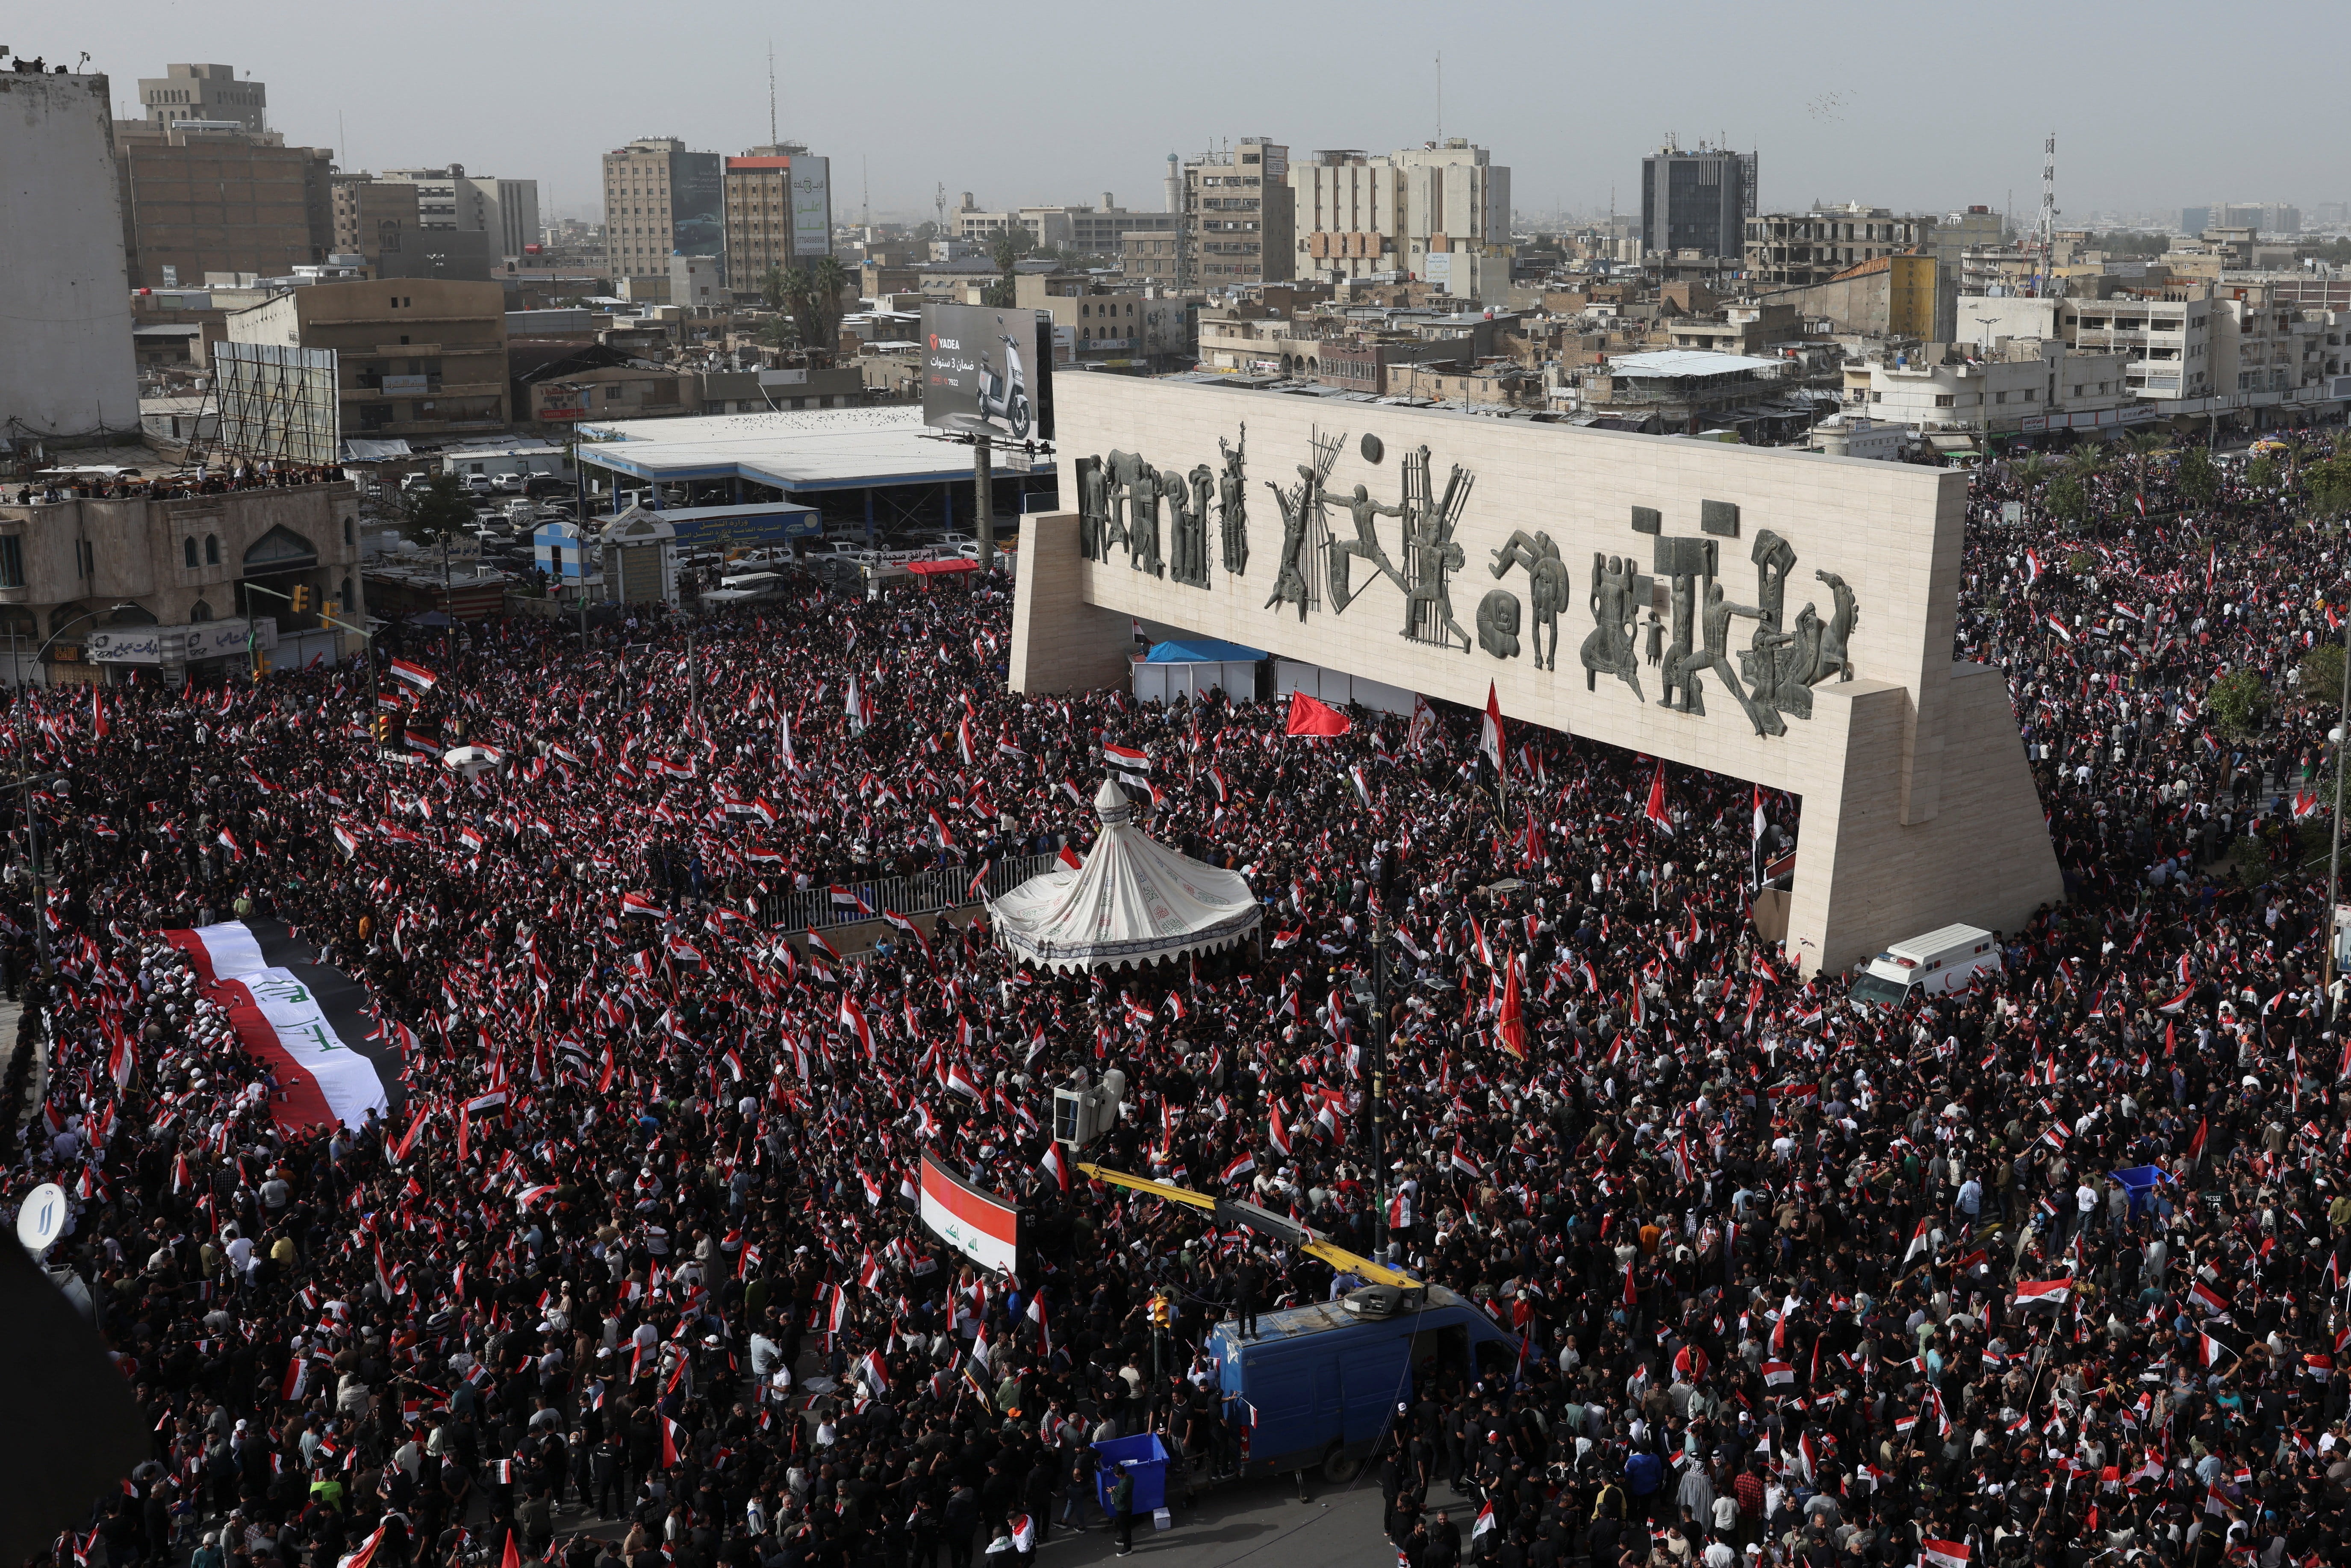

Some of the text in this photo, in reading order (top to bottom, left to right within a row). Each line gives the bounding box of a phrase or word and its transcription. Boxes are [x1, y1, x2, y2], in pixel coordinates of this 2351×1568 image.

[797, 219, 825, 230] هنا
[939, 338, 960, 350] YADEA
[931, 355, 974, 372] ضمان 3 سنوات
[948, 378, 958, 386] 7922
[699, 520, 728, 530] النقل
[883, 551, 930, 563] مرافق صحية
[55, 646, 78, 661] النافذة
[252, 980, 310, 1003] الله
[2207, 1202, 2221, 1213] 10
[945, 1224, 978, 1252] الله اكبر
